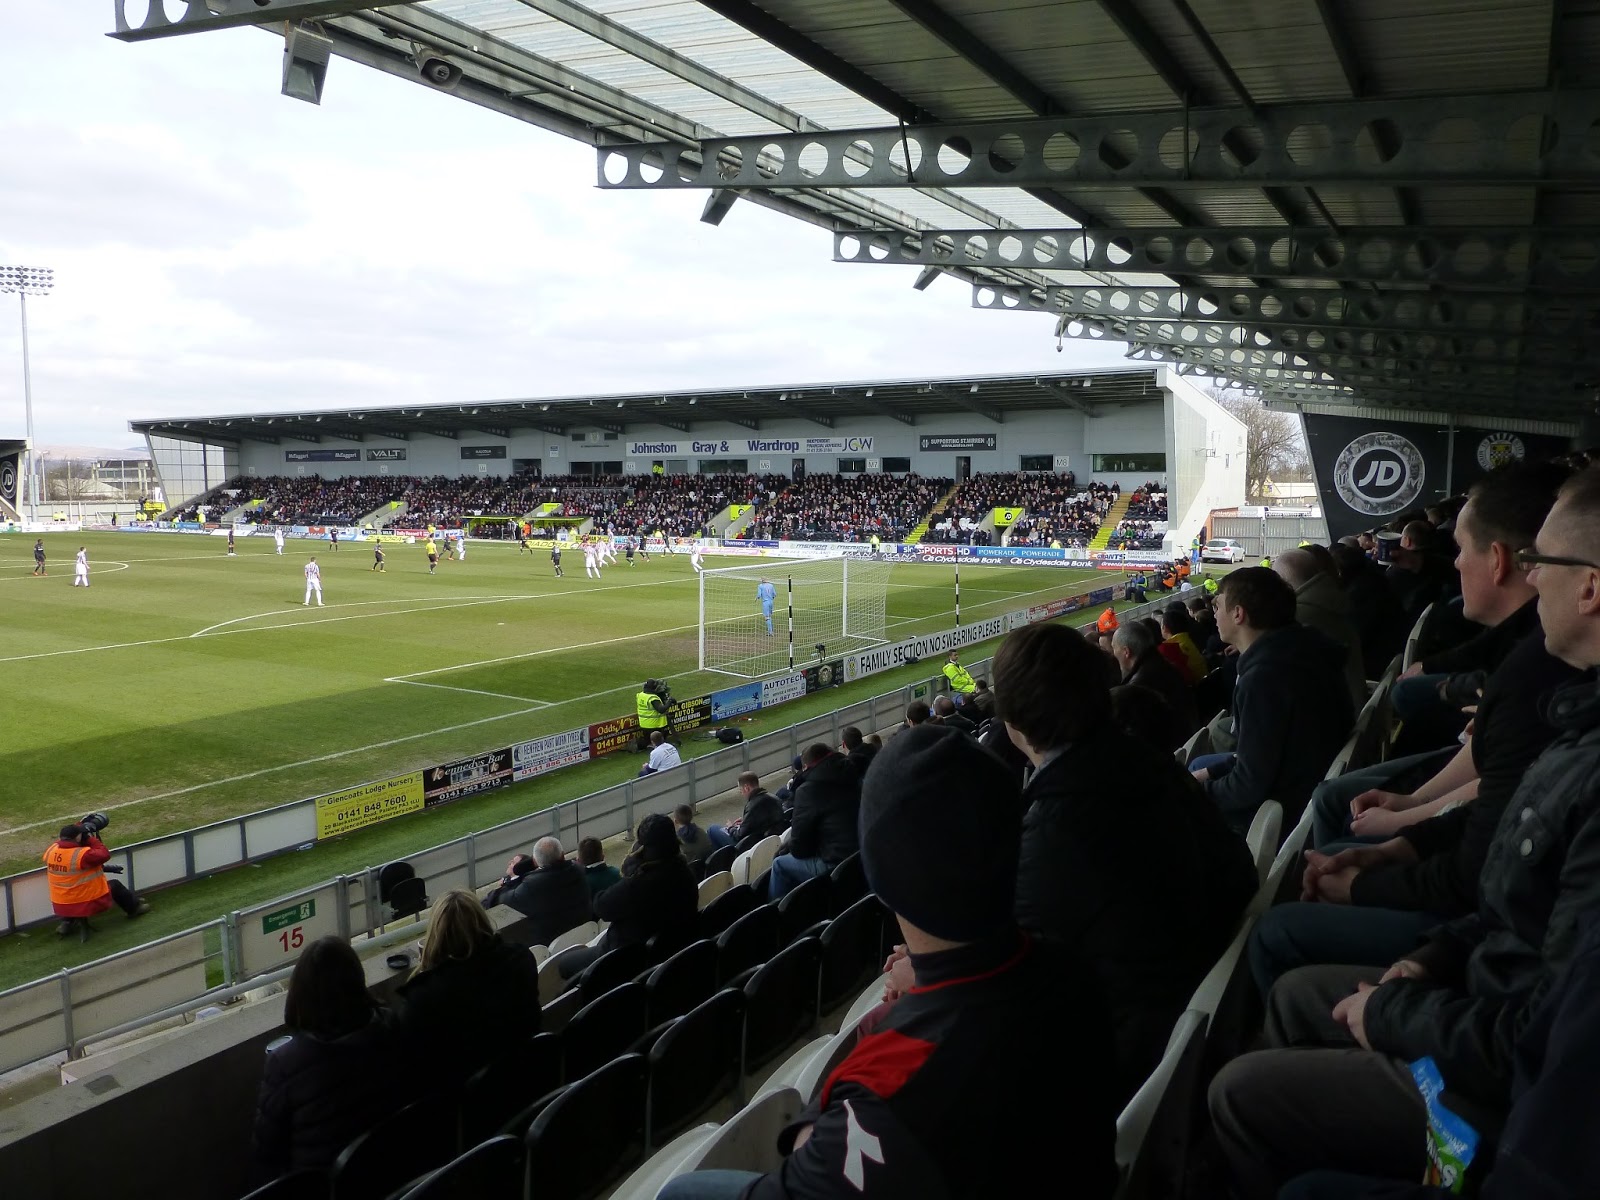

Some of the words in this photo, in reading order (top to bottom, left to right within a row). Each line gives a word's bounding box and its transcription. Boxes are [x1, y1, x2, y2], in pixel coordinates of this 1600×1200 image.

[631, 443, 677, 454] Johnston
[692, 441, 717, 454] Gray
[720, 440, 729, 452] &
[747, 440, 799, 453] Wardrop
[842, 437, 872, 452] JGW
[4, 473, 13, 486] JD
[1358, 460, 1402, 487] JD
[935, 555, 980, 563] Clydesdale
[1021, 549, 1061, 557] POWERADE
[1023, 558, 1070, 567] Clydesdale
[860, 653, 891, 674] FAMILY
[893, 640, 928, 664] SECTION
[929, 637, 940, 653] NO
[941, 626, 977, 649] SWEARING
[978, 619, 1000, 639] PLEASE
[763, 674, 805, 691] AUTOTECH
[668, 704, 680, 713] AUL
[681, 697, 703, 710] GIBSON
[674, 708, 695, 718] AUTOS
[597, 724, 616, 736] Odds
[544, 737, 555, 749] PART
[567, 731, 580, 743] TYRES
[596, 738, 614, 750] 0141
[617, 733, 630, 744] 887
[488, 754, 506, 764] Bar
[521, 765, 542, 775] 0141
[327, 790, 363, 805] Glencoats
[365, 784, 386, 796] Lodge
[388, 776, 414, 789] Nursery
[439, 789, 460, 800] 0141
[463, 784, 478, 794] 562
[338, 808, 361, 821] 0141
[364, 802, 381, 813] 848
[384, 794, 407, 807] 7600
[380, 805, 398, 813] Paisley
[53, 852, 63, 863] 16
[268, 909, 297, 923] Emergency
[278, 926, 304, 952] 15
